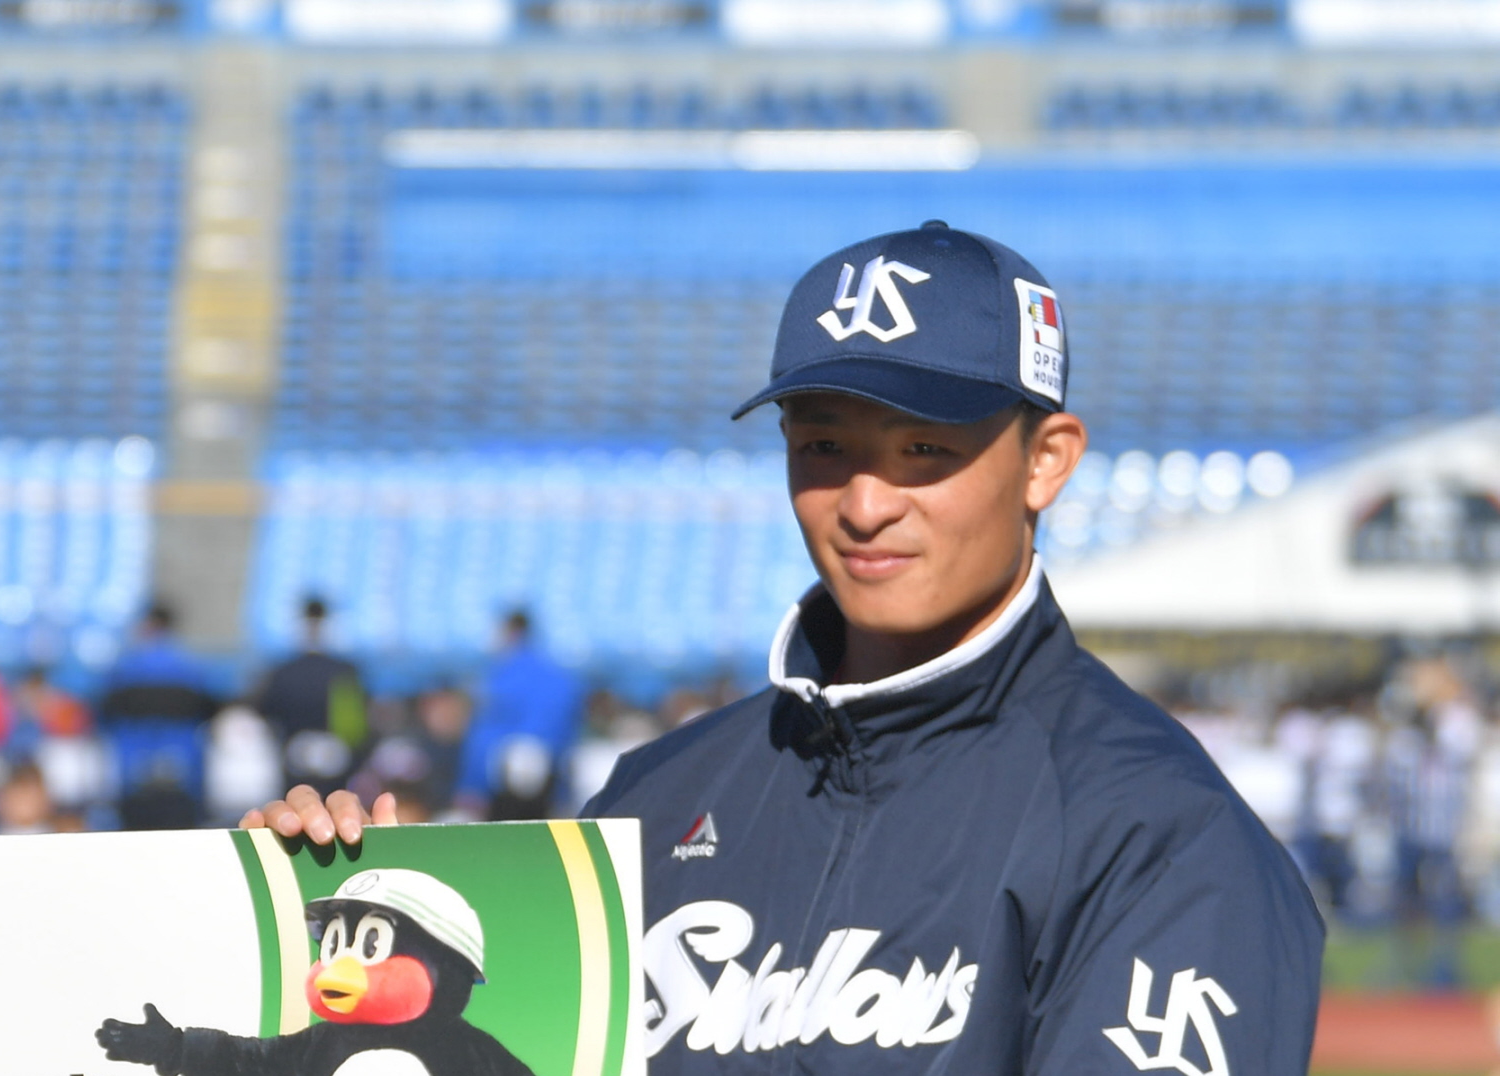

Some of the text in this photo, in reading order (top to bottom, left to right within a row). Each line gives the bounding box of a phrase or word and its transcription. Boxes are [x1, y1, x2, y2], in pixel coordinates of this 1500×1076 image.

[1033, 350, 1060, 372] OPE
[1033, 369, 1062, 389] HOUS
[643, 900, 978, 1058] Swallows
